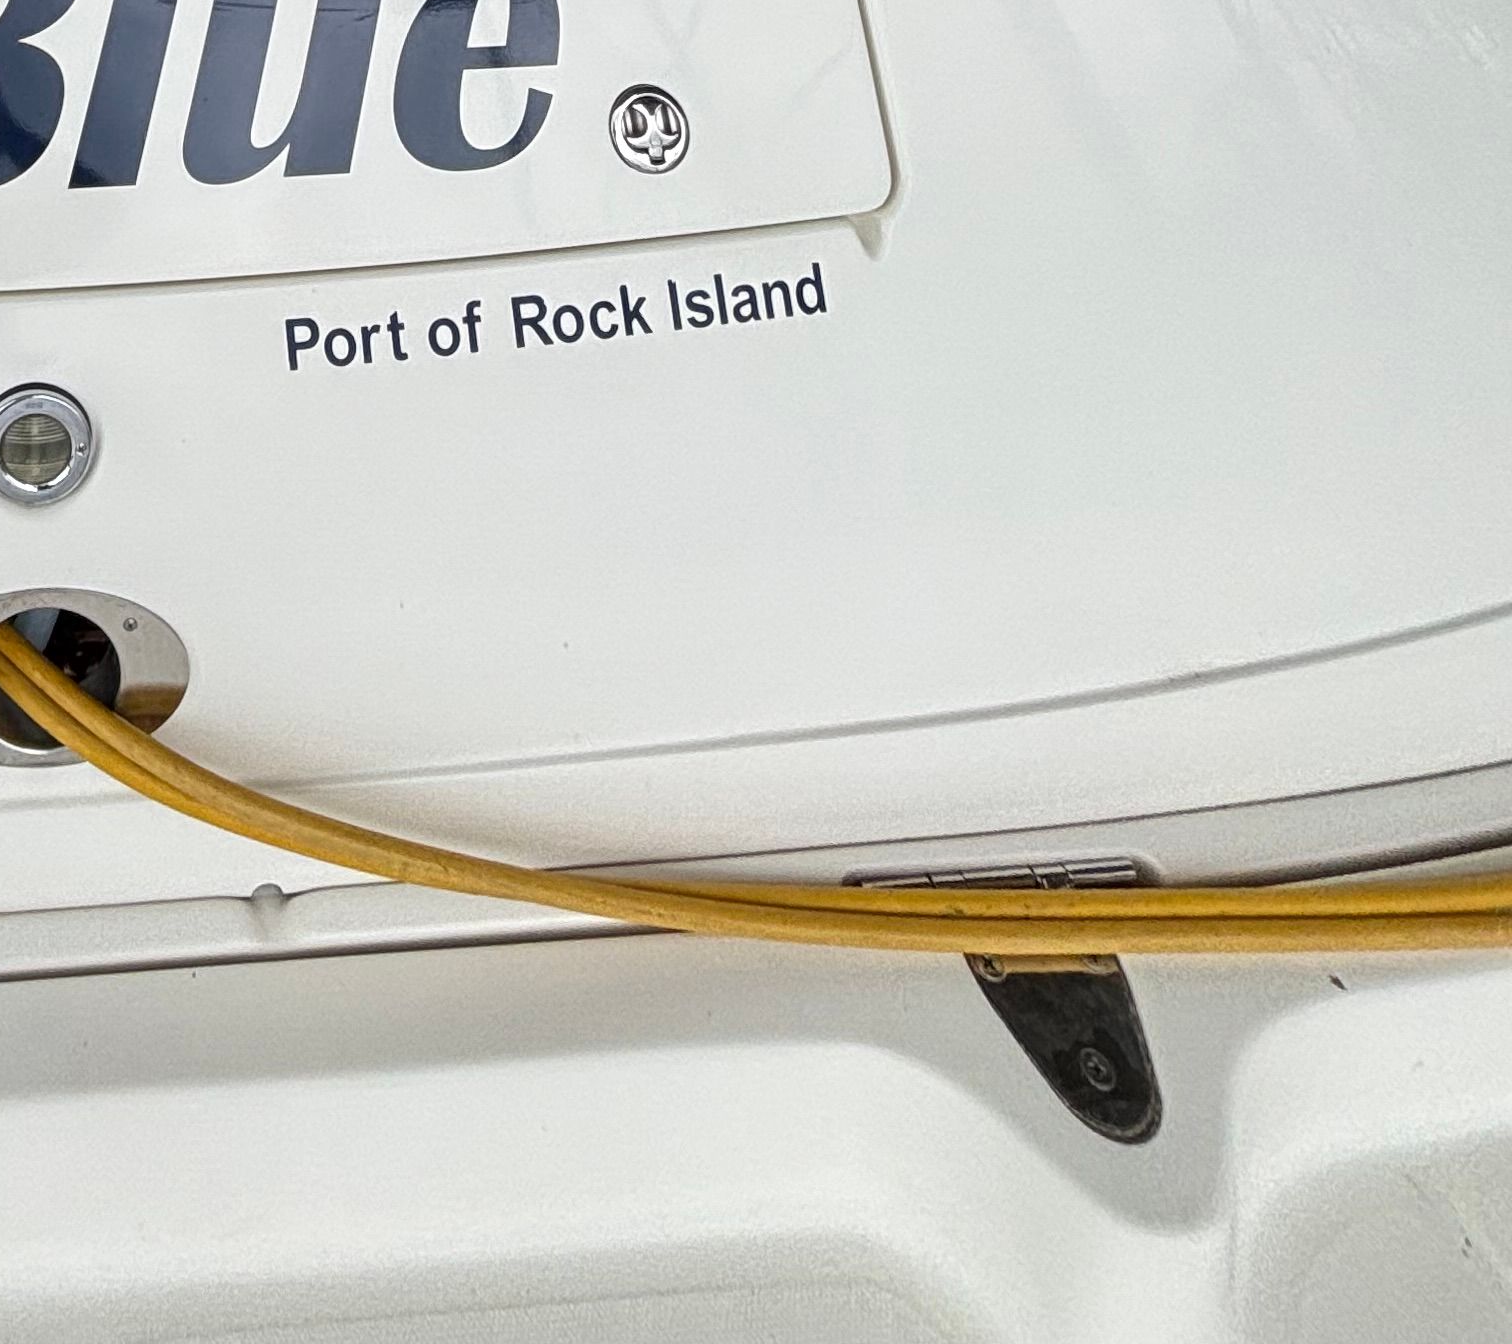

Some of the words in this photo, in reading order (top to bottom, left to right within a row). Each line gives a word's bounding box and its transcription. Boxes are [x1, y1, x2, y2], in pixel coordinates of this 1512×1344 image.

[285, 309, 409, 371] Port
[427, 300, 483, 358] of
[509, 283, 655, 349] Rock
[666, 262, 828, 332] Island
